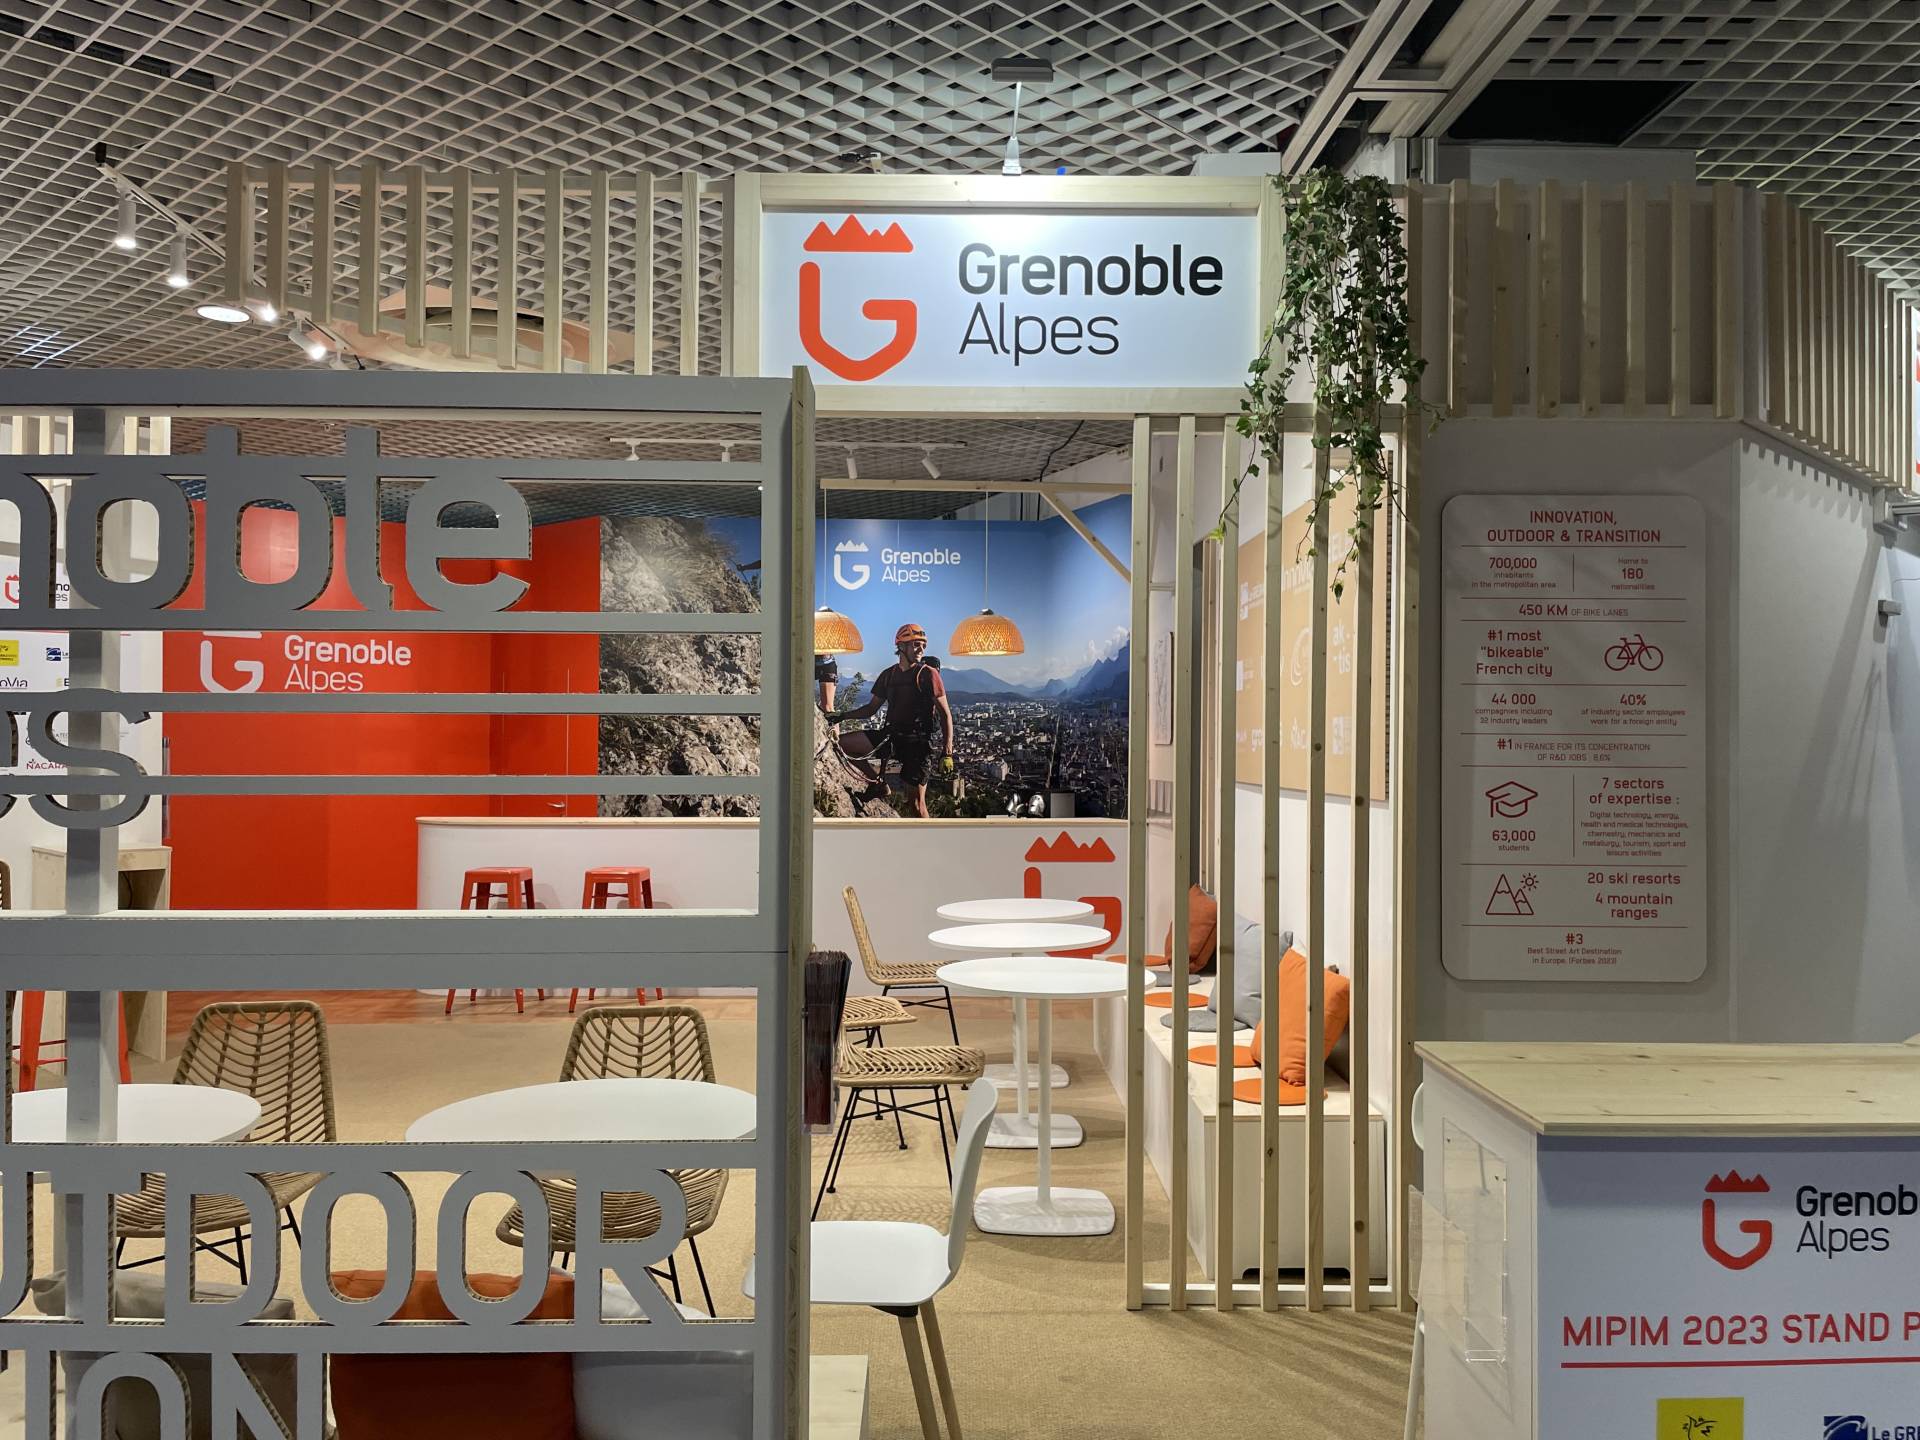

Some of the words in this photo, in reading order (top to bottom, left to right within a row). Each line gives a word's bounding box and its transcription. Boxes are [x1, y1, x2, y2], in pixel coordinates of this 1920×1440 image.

[959, 243, 1223, 296] Grenoble
[959, 302, 1120, 367] Alpes
[1530, 510, 1618, 525] INNOVATION,
[1487, 529, 1554, 542] OUTDOOR
[1560, 530, 1570, 542] &
[1576, 530, 1661, 543] TRANSITION
[881, 548, 961, 565] Grenoble
[1489, 557, 1537, 570] 700,000
[881, 567, 930, 585] Alpes
[1494, 571, 1534, 579] inhabitants
[1622, 568, 1644, 580] 180
[1471, 581, 1479, 589] in
[1480, 581, 1492, 589] the
[1493, 581, 1539, 591] metropolitan
[1519, 604, 1543, 616] 450
[1547, 605, 1568, 616] KM
[1571, 609, 1582, 617] OF
[1583, 609, 1601, 617] BIKE
[1603, 609, 1629, 617] LANES
[1487, 629, 1503, 641] #1
[1507, 630, 1542, 641] most
[284, 634, 412, 666] Grenoble
[1480, 646, 1550, 658] "bikeable"
[1476, 663, 1522, 675] French
[1527, 663, 1553, 677] city
[284, 664, 364, 693] Alpes
[1491, 693, 1507, 705] 44
[1511, 693, 1537, 705] 000
[1620, 694, 1647, 706] 40%
[1521, 708, 1553, 716] including
[1591, 708, 1620, 716] industry
[1490, 717, 1520, 725] industry
[1629, 718, 1654, 726] foreign
[1655, 718, 1677, 726] entity
[1497, 738, 1513, 750] #1
[1514, 743, 1522, 751] IN
[1523, 743, 1556, 751] FRANCE
[1557, 743, 1573, 751] FOR
[1574, 743, 1586, 751] ITS
[1587, 743, 1651, 751] CONCENTRATION
[1537, 753, 1547, 761] OF
[1549, 753, 1566, 761] R&D
[1568, 753, 1587, 761] JOBS
[1602, 777, 1609, 789] 7
[1613, 778, 1665, 789] sectors
[1589, 792, 1602, 804] of
[1607, 793, 1672, 806] expertise
[1492, 830, 1536, 844] 63,000
[1498, 844, 1530, 852] students
[1587, 872, 1603, 884] 20
[1609, 872, 1628, 884] ski
[1632, 873, 1681, 885] resorts
[1595, 893, 1603, 904] 4
[1607, 893, 1673, 905] mountain
[1611, 908, 1658, 920] ranges
[1566, 933, 1584, 945] #3
[1527, 947, 1544, 955] Best
[1545, 947, 1567, 955] Street
[1568, 947, 1580, 955] Art
[1581, 947, 1622, 955] Destination
[1796, 1184, 1918, 1217] Grenob
[1796, 1220, 1890, 1259] Alpes
[1563, 1316, 1668, 1346] MIPIM
[1683, 1314, 1768, 1346] 2023
[1782, 1312, 1889, 1344] STAND
